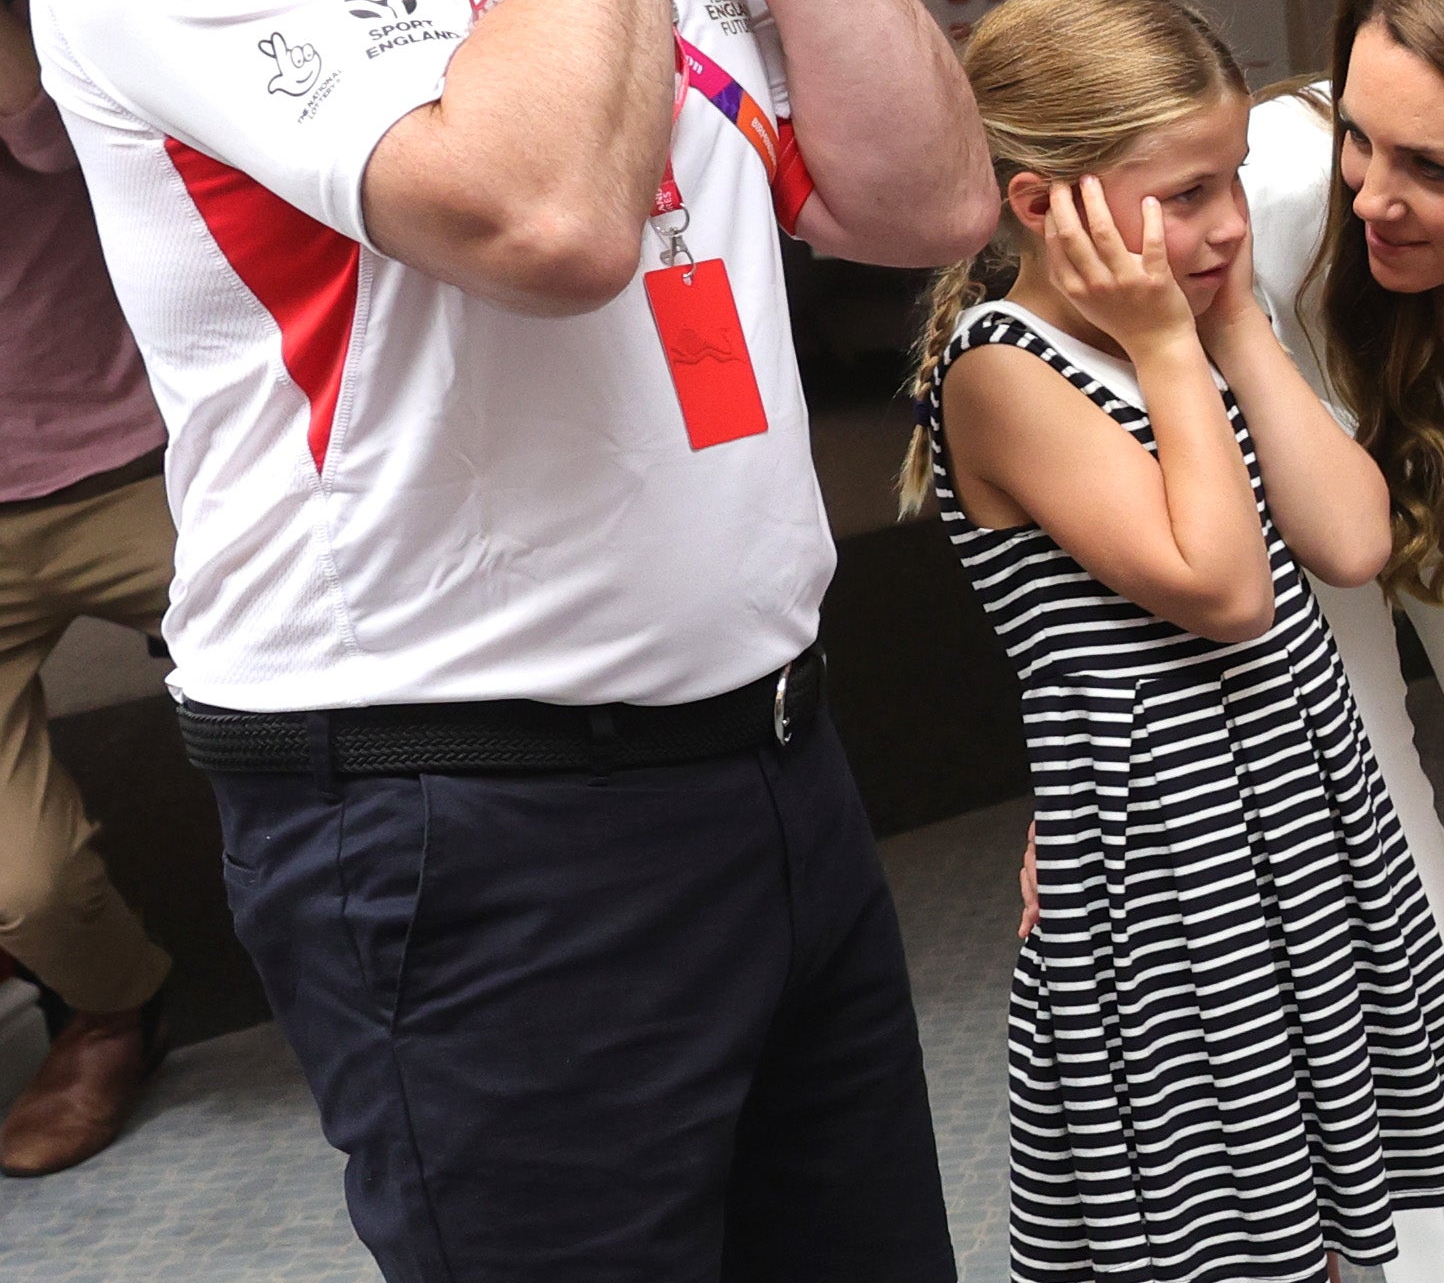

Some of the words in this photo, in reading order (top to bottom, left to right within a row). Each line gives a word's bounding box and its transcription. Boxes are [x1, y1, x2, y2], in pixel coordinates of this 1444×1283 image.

[704, 3, 750, 20] ENGLA
[368, 20, 433, 41] SPORT
[365, 30, 461, 60] ENGLAND
[306, 69, 342, 108] NATIONAL
